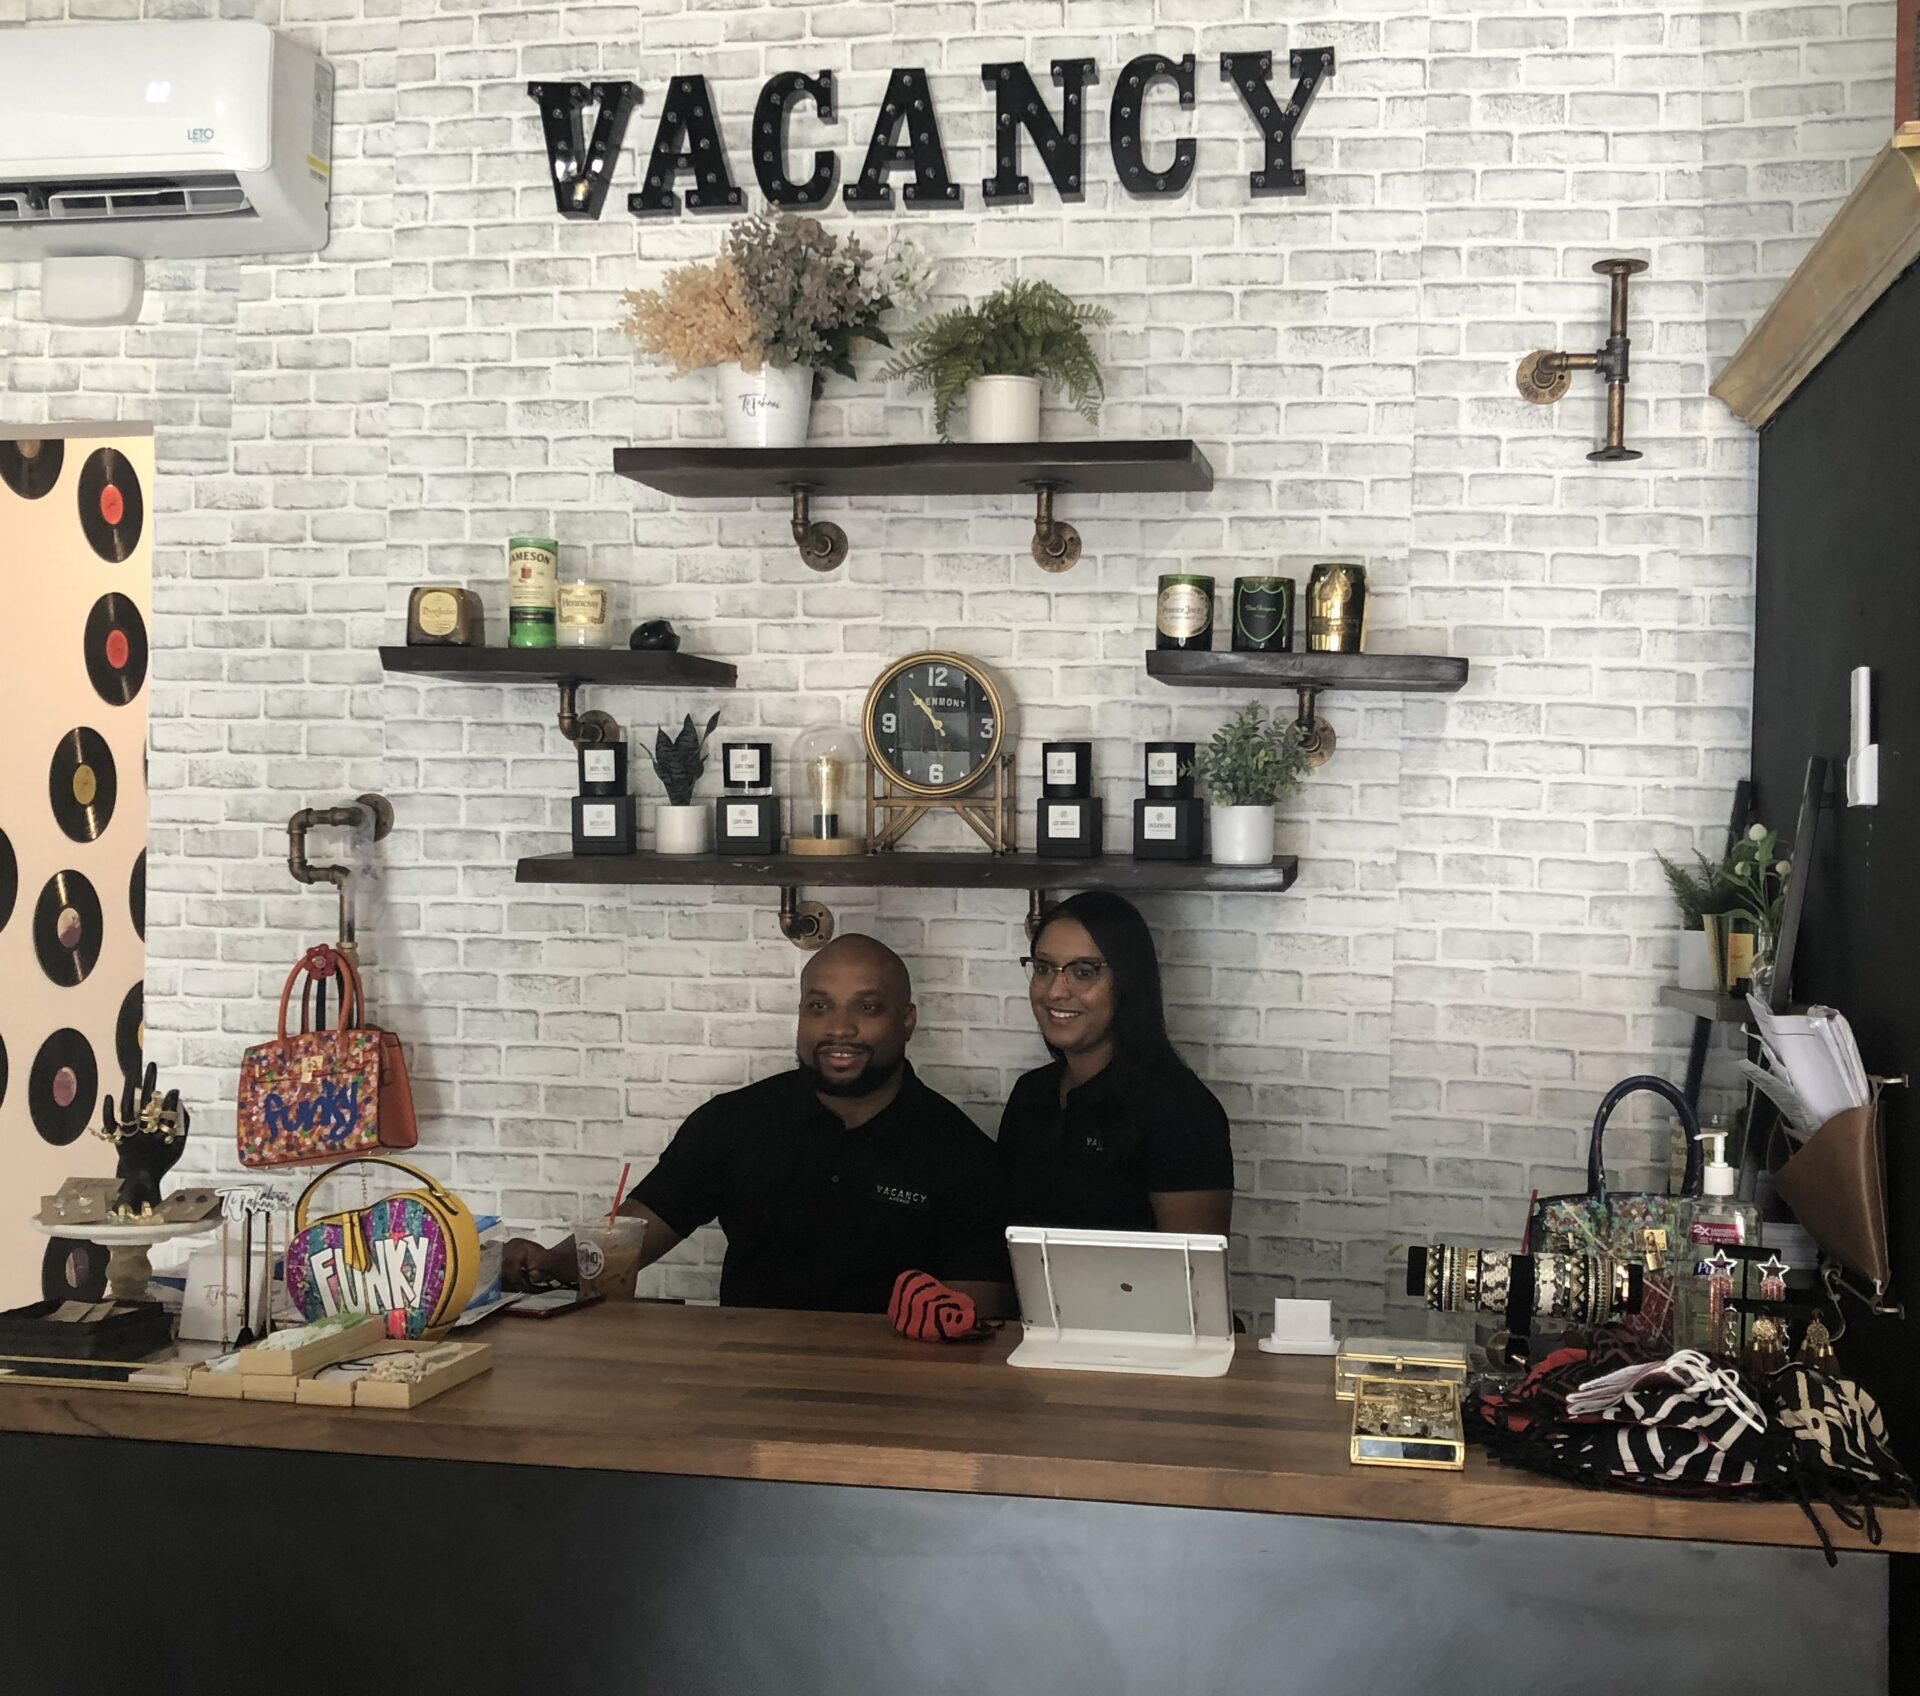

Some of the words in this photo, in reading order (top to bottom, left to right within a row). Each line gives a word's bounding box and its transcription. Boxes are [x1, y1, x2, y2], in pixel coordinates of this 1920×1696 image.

[187, 128, 214, 140] LETO
[527, 46, 1335, 221] VACANCY
[511, 551, 551, 565] AMESON
[928, 667, 949, 687] 12
[881, 712, 897, 733] 9
[980, 718, 994, 739] 3
[928, 763, 944, 784] 6
[876, 1184, 928, 1204] VACANCY
[1693, 1225, 1710, 1236] 2X
[310, 1236, 429, 1318] FUNKY
